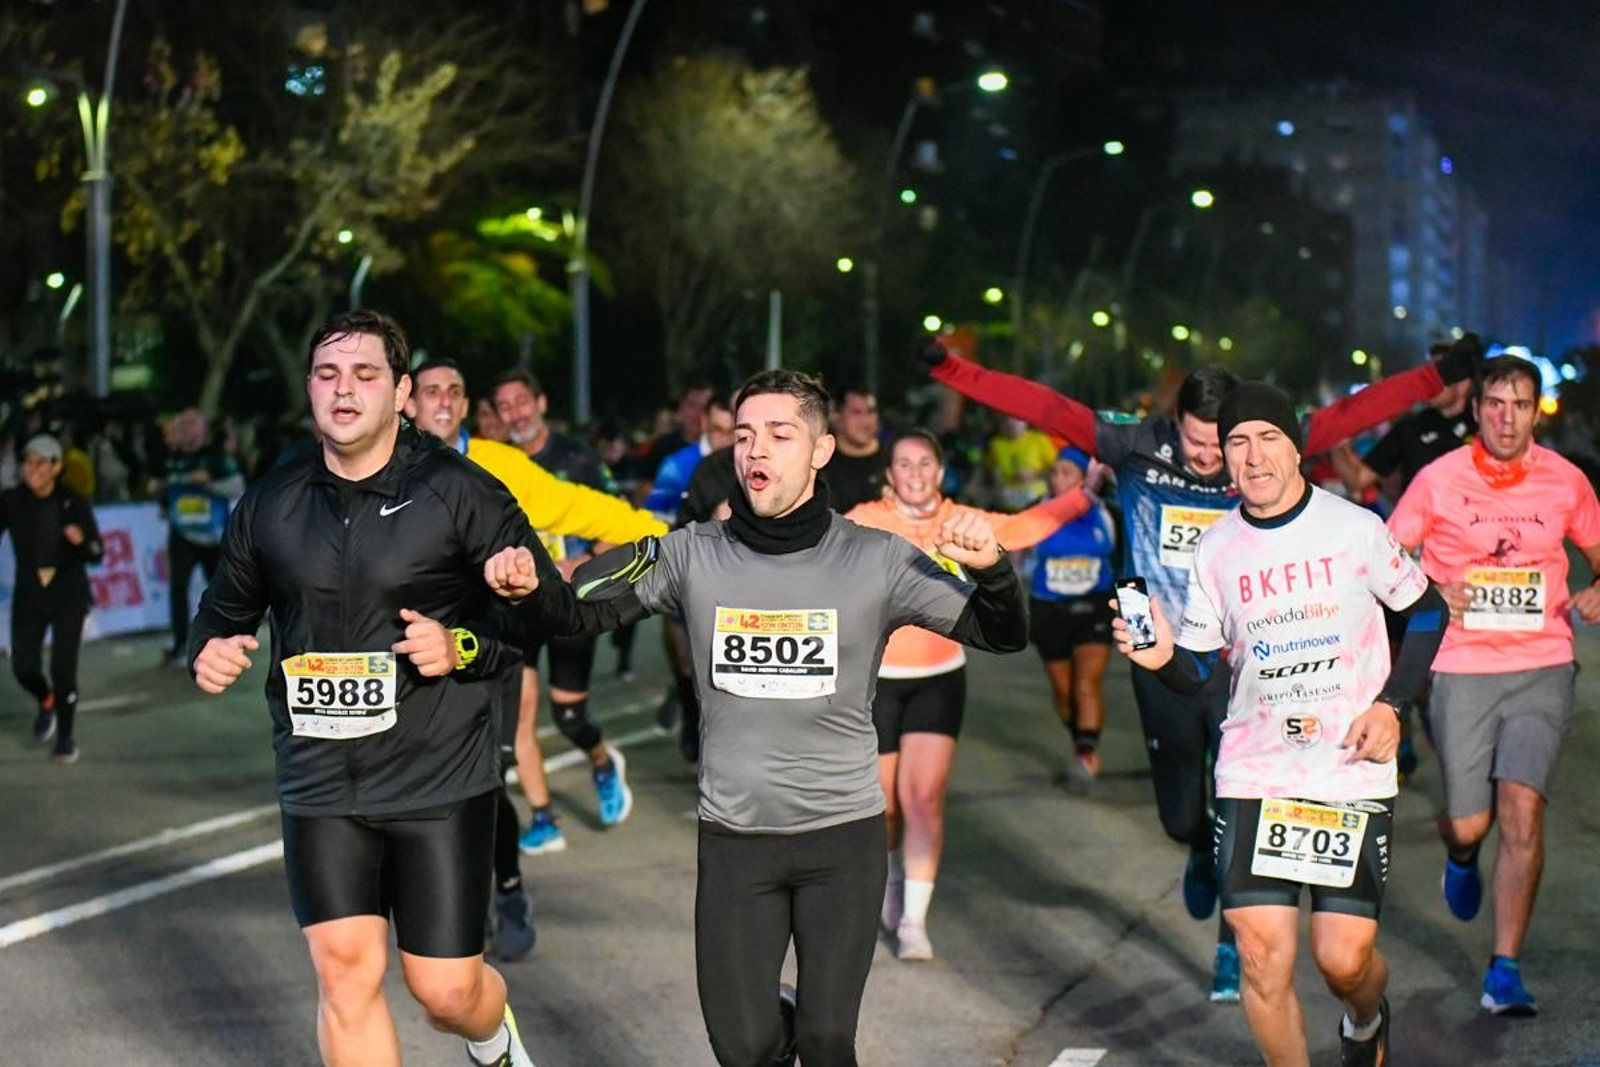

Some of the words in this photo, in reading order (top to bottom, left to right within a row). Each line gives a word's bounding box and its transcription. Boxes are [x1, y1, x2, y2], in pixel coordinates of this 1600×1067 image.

[1145, 469, 1185, 488] SAN
[1239, 557, 1333, 603] BKFIT
[740, 614, 760, 629] 42
[1246, 602, 1341, 634] nevadaBike
[723, 634, 825, 665] 8502
[1272, 634, 1341, 654] nutrinovex
[307, 658, 325, 672] 42
[1258, 656, 1341, 680] SCOTT
[297, 678, 385, 707] 5988
[1268, 823, 1351, 857] 8703
